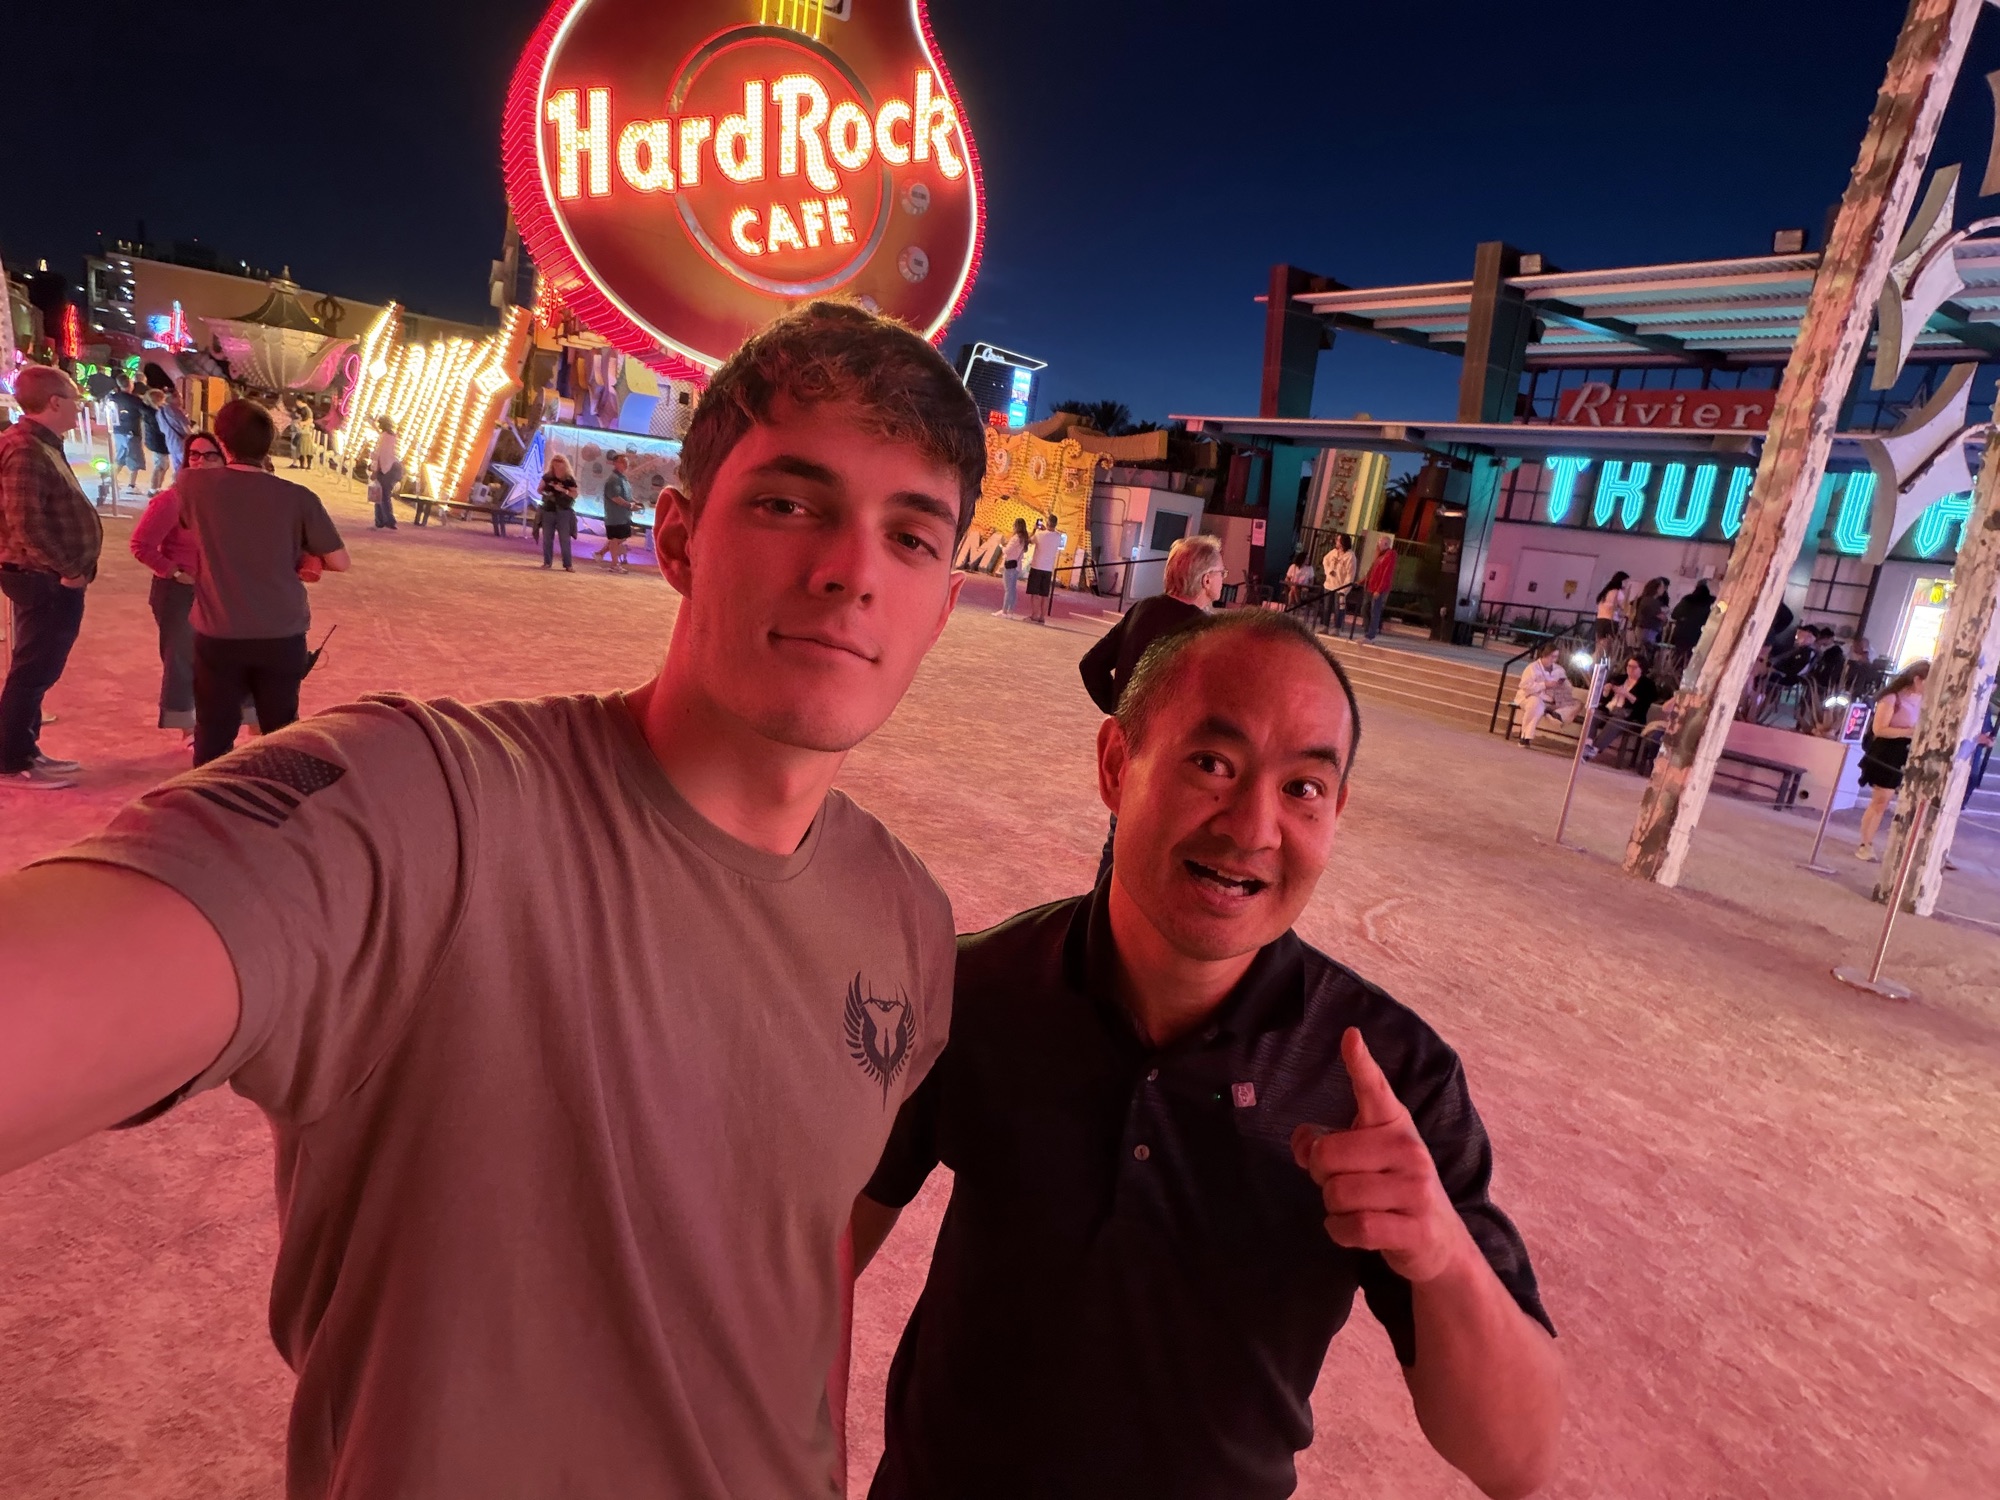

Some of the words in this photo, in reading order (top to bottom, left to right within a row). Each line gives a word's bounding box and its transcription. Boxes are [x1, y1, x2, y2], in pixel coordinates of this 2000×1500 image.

[730, 195, 857, 256] CAFE
[1562, 382, 1764, 428] Rivier
[1325, 455, 1358, 528] SAH
